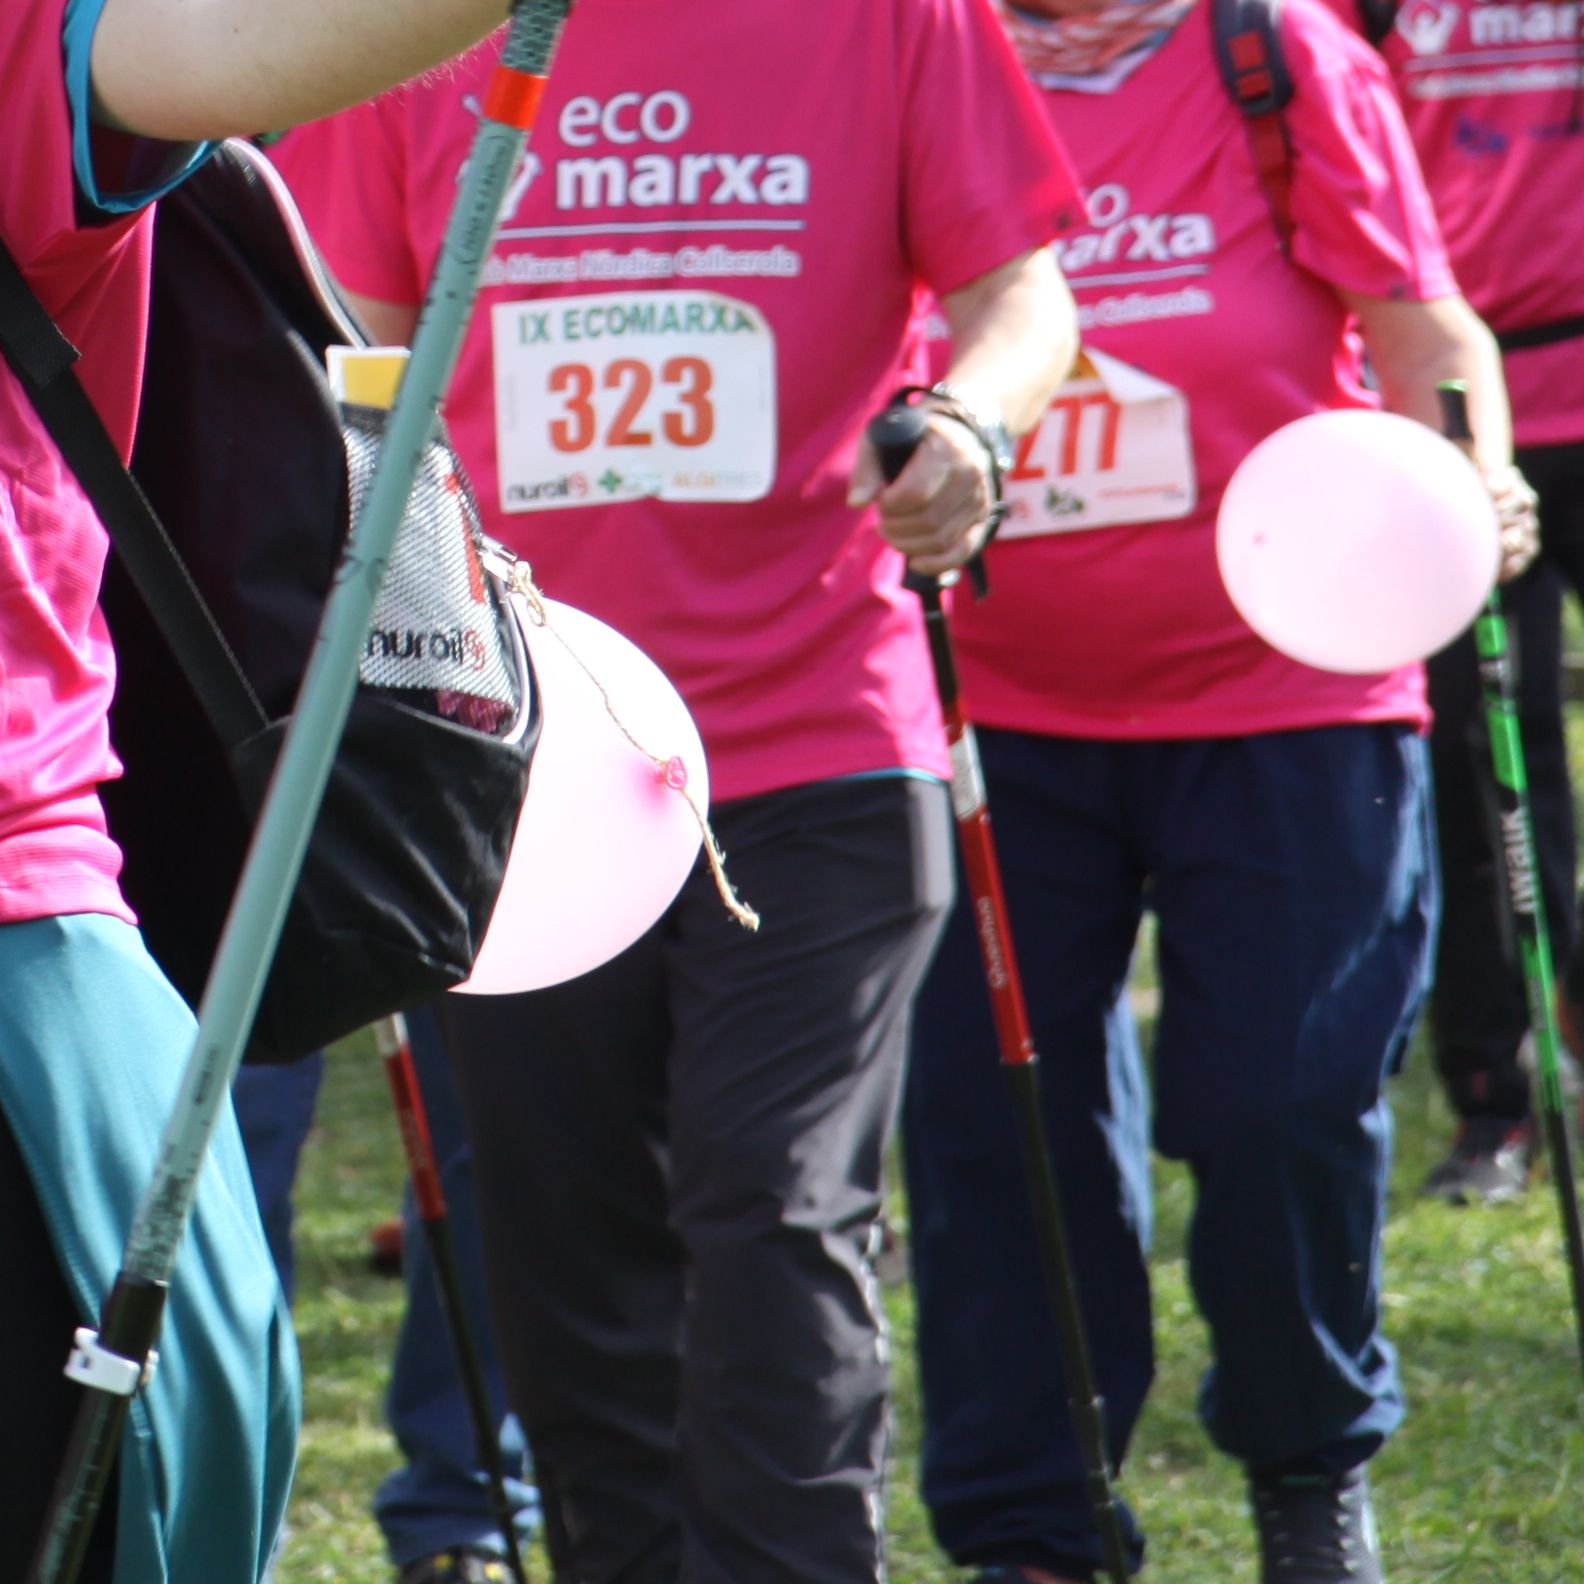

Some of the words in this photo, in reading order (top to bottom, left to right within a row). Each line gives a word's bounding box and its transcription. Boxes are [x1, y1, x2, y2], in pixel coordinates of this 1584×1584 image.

[557, 89, 691, 148] eco
[554, 153, 811, 210] marxa
[518, 313, 551, 346] IX
[562, 302, 756, 342] ECOMARXA
[546, 354, 716, 454] 323
[367, 628, 464, 665] nuroil
